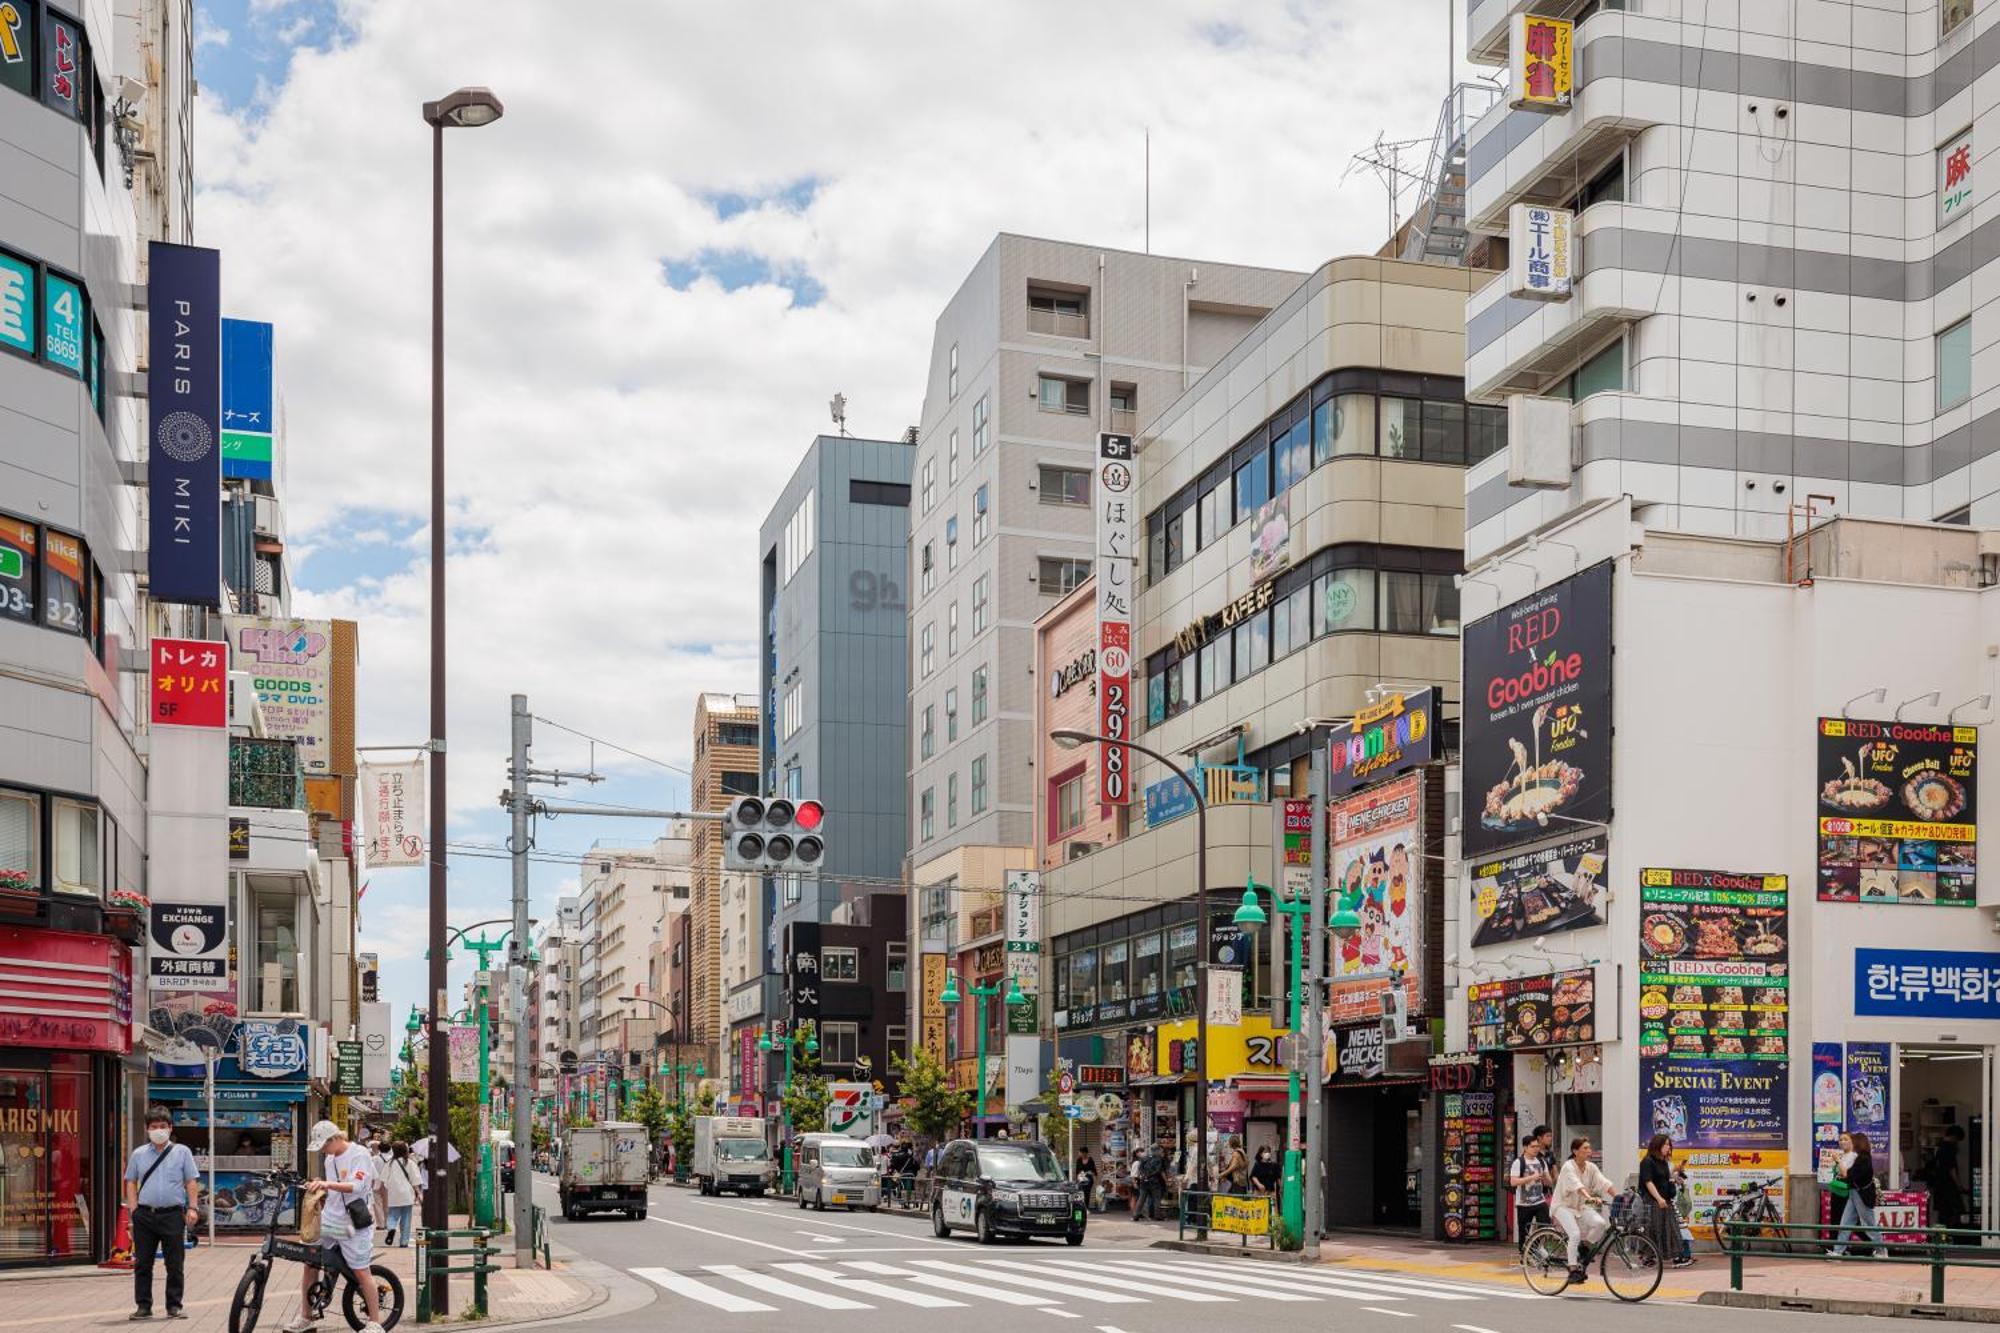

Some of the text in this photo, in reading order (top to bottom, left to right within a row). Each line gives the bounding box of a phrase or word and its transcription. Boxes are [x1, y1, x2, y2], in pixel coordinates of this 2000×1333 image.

[54, 25, 76, 100] トレカ
[1945, 144, 1971, 193] 麻
[1944, 190, 1972, 213] フリー
[54, 290, 74, 324] 4
[54, 322, 77, 342] TEL
[174, 300, 190, 394] PARIS
[1108, 437, 1127, 455] 5F
[174, 478, 190, 544] MIKI
[1104, 502, 1128, 615] ほぐし処
[1508, 607, 1562, 655] RED
[160, 648, 217, 667] トレカ
[1105, 650, 1126, 669] 60
[158, 677, 220, 694] オリパ
[254, 678, 311, 692] GOODS
[1487, 652, 1582, 710] Goobne
[159, 703, 178, 716] 5F
[1551, 715, 1577, 738] UFO
[1847, 723, 1881, 738] RED
[1892, 725, 1951, 742] Goobne
[1107, 686, 1127, 799] 2,980
[1872, 750, 1895, 761] UFO
[1950, 756, 1971, 767] UFO
[1673, 872, 1703, 886] RED
[162, 914, 214, 924] EXCHANGE
[160, 959, 216, 974] 外貨両替
[1674, 961, 1703, 974] RED
[1713, 963, 1764, 976] Goobne
[1348, 1028, 1382, 1048] NENE
[1340, 1046, 1385, 1066] CHICKE
[1431, 1065, 1472, 1090] RED
[1486, 1059, 1496, 1088] RED
[1654, 1071, 1773, 1089] SPECIAL EVENT
[1877, 1211, 1915, 1228] ALE
